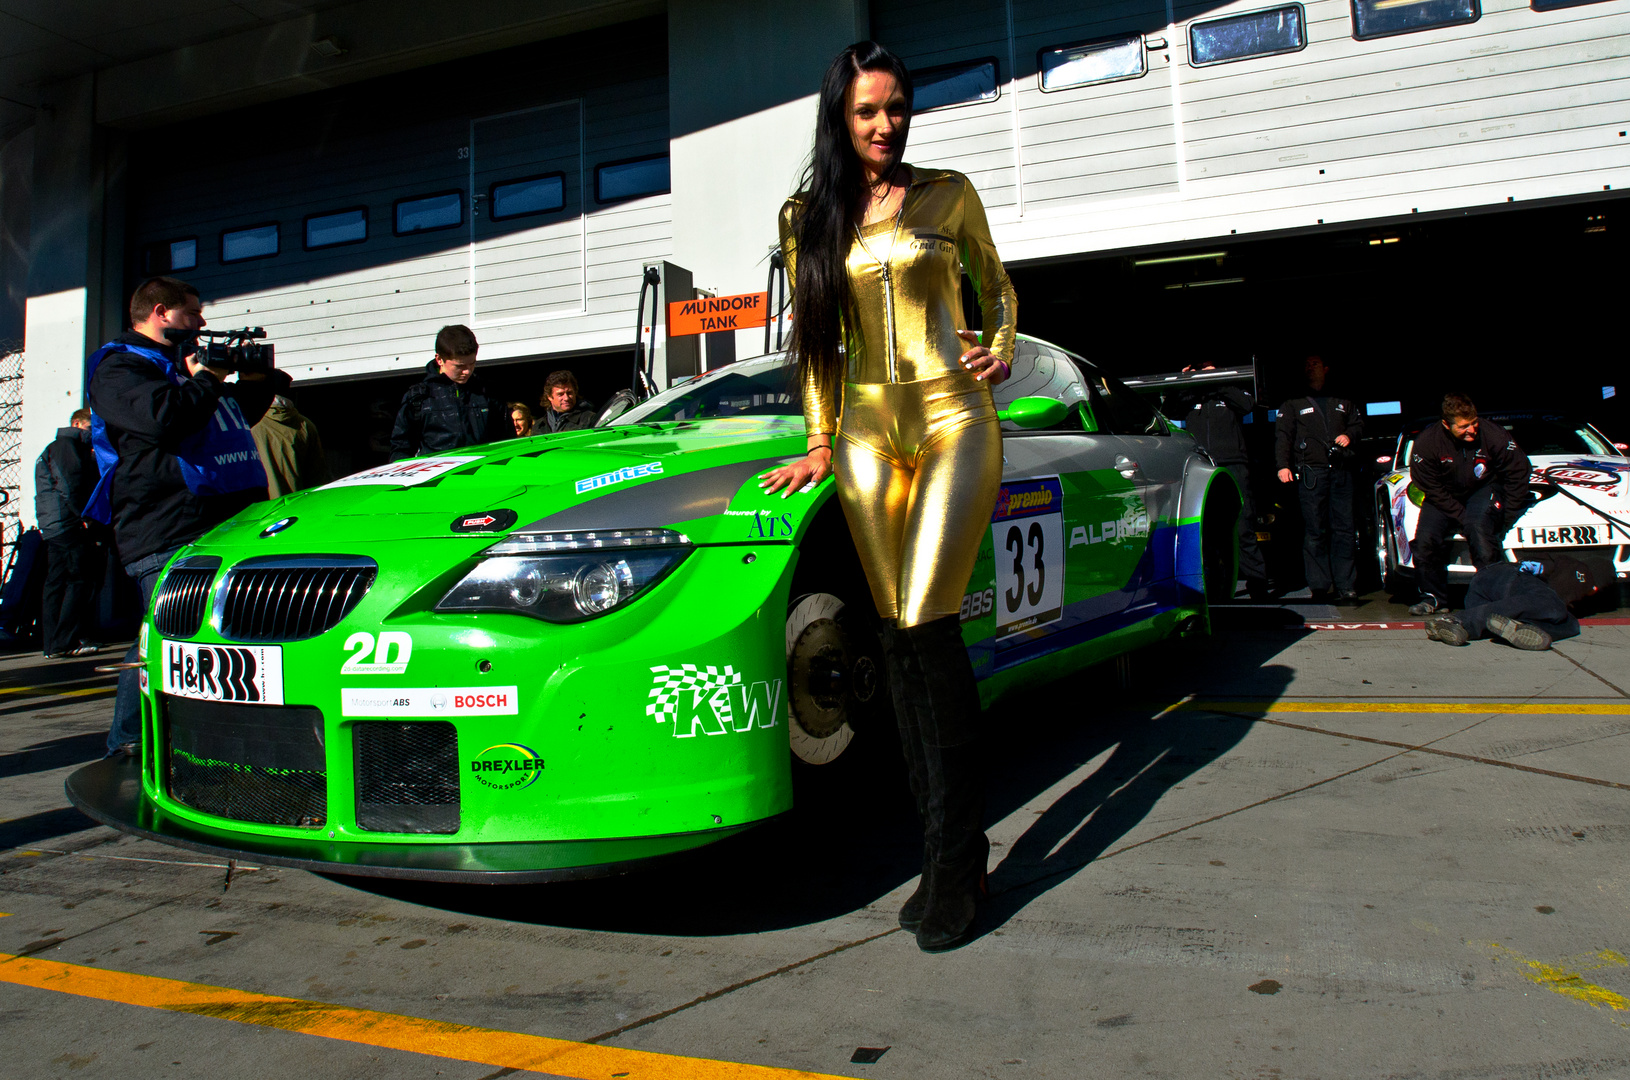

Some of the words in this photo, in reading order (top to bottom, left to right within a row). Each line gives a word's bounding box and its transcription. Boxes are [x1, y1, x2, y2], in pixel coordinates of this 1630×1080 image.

[457, 147, 469, 159] 33
[939, 241, 954, 254] Girl
[680, 296, 760, 316] MUNDORF
[700, 315, 738, 330] TANK
[1008, 485, 1053, 516] premio
[724, 508, 756, 517] Insured
[760, 509, 772, 518] by
[1069, 514, 1150, 549] ALPINA
[1531, 526, 1573, 544] H&R
[1005, 521, 1045, 613] 33
[959, 588, 994, 620] BBS
[340, 631, 413, 665] 2D
[169, 643, 223, 700] H&R
[454, 694, 508, 708] BOSCH
[672, 678, 782, 738] KW
[471, 758, 545, 774] DREXLER
[475, 772, 529, 790] MOTORSPORT
